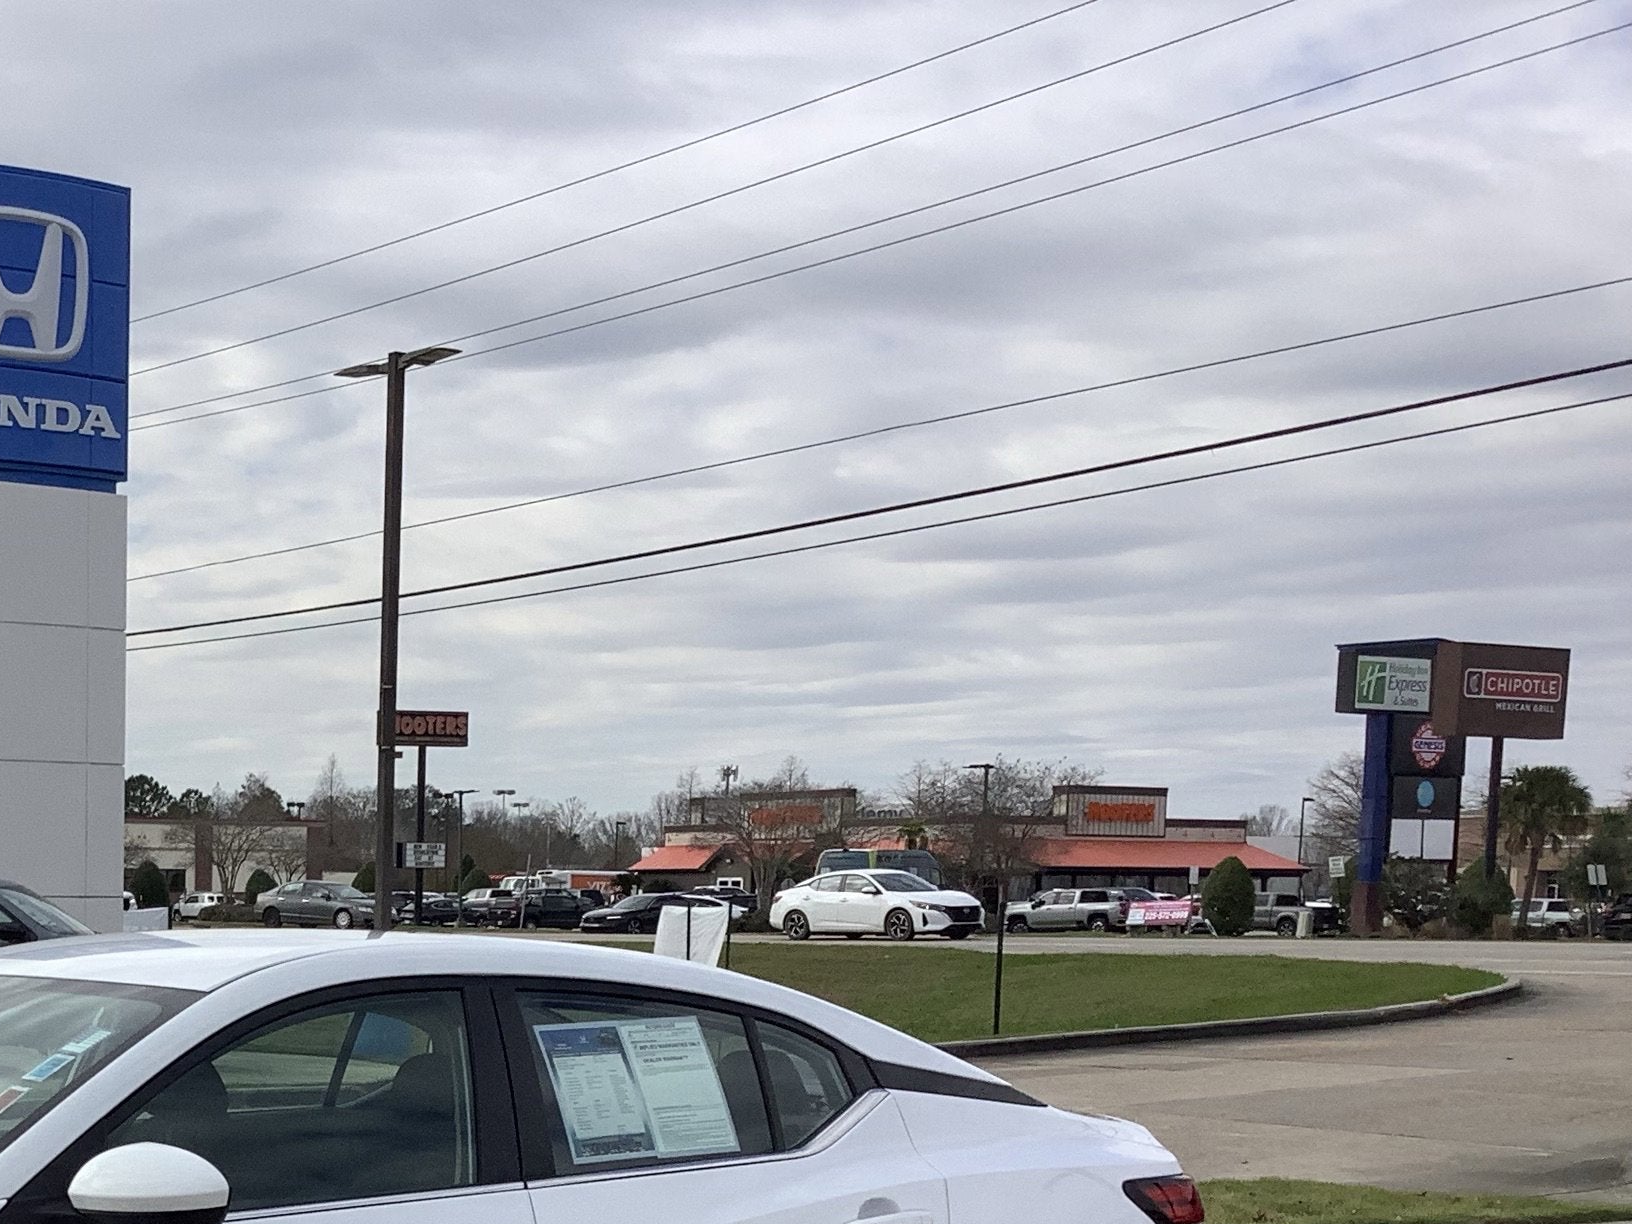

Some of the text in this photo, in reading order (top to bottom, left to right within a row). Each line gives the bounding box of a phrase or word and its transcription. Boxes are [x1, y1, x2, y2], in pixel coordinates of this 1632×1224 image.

[1388, 675, 1427, 695] Express
[1487, 676, 1558, 695] CHIPOTLE
[1495, 702, 1555, 713] MEXICAN GRILL
